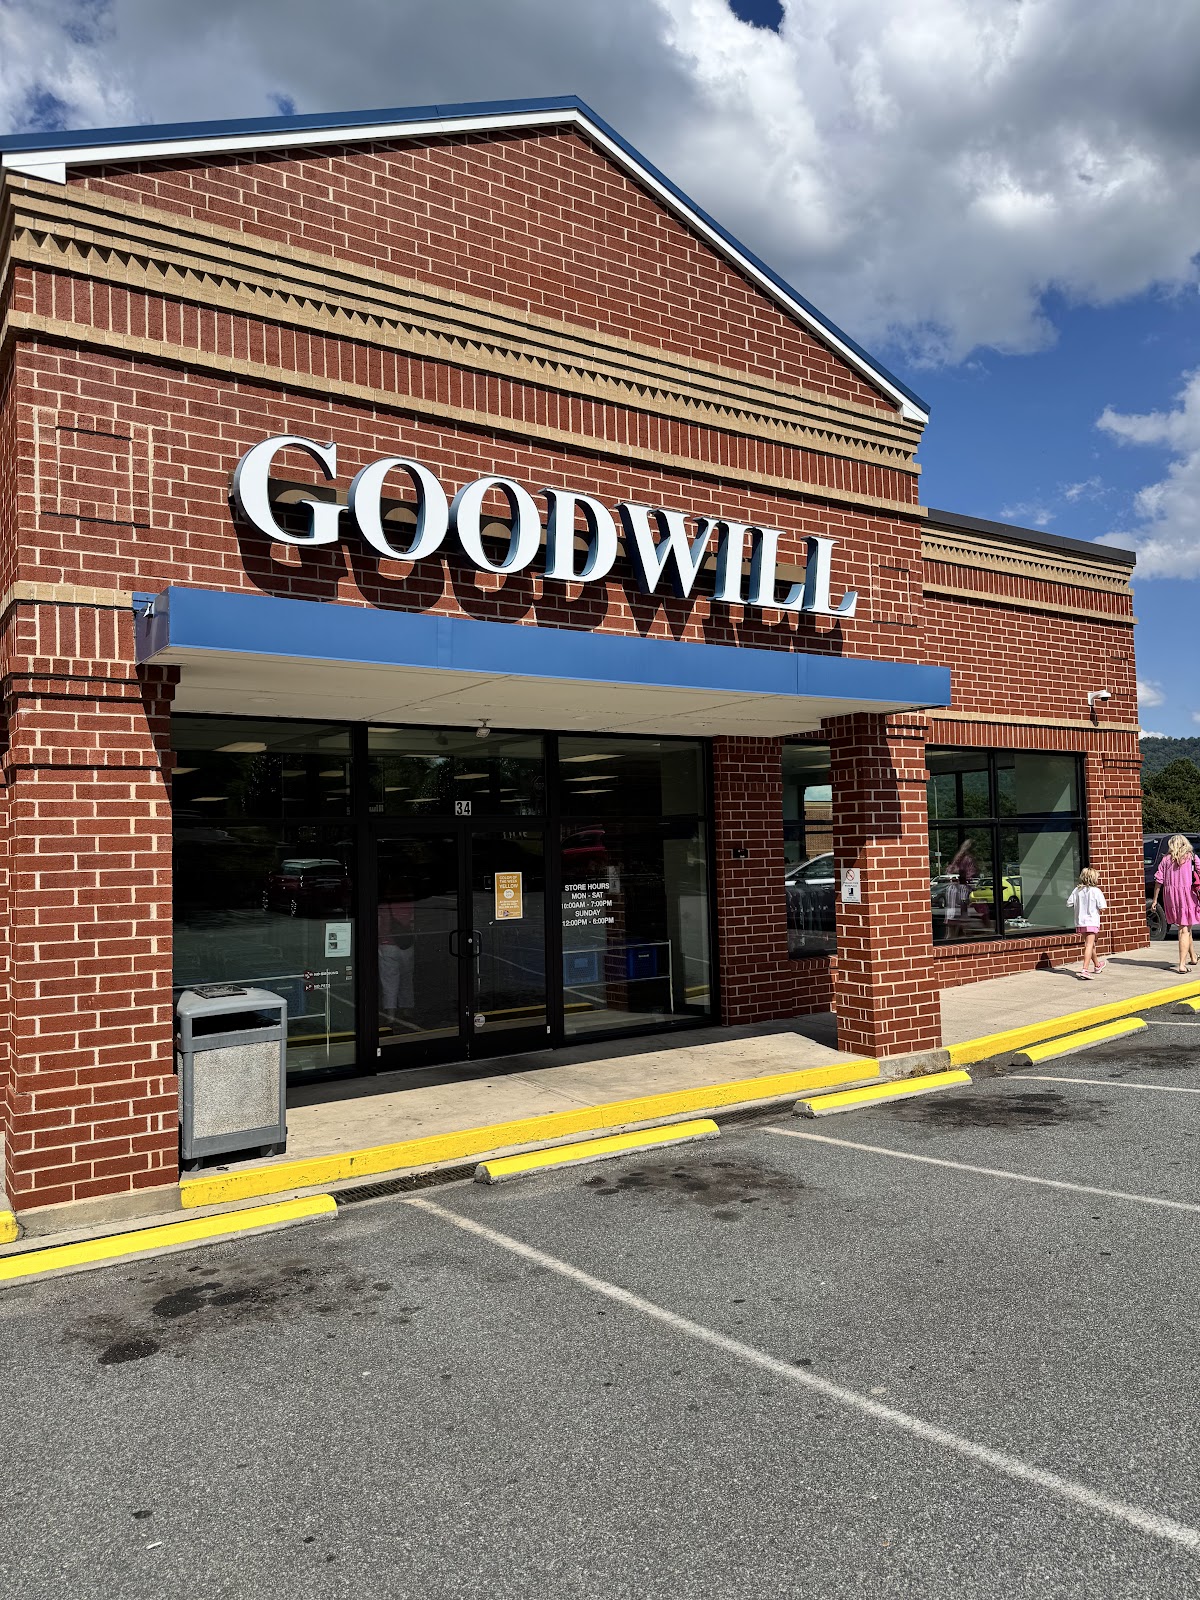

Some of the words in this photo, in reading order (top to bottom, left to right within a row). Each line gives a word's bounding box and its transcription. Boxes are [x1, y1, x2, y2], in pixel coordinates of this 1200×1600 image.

[233, 434, 857, 619] GOODWILL
[456, 801, 471, 815] 34
[564, 883, 587, 891] STORE
[587, 882, 610, 890] HOURS
[571, 892, 587, 900] MON
[591, 891, 604, 899] SAT
[561, 901, 586, 910] 10:00AM
[590, 899, 613, 907] 7:00PM
[574, 908, 601, 917] SUNDAY
[562, 918, 588, 927] 12:00PM
[592, 916, 615, 925] 6:00PM
